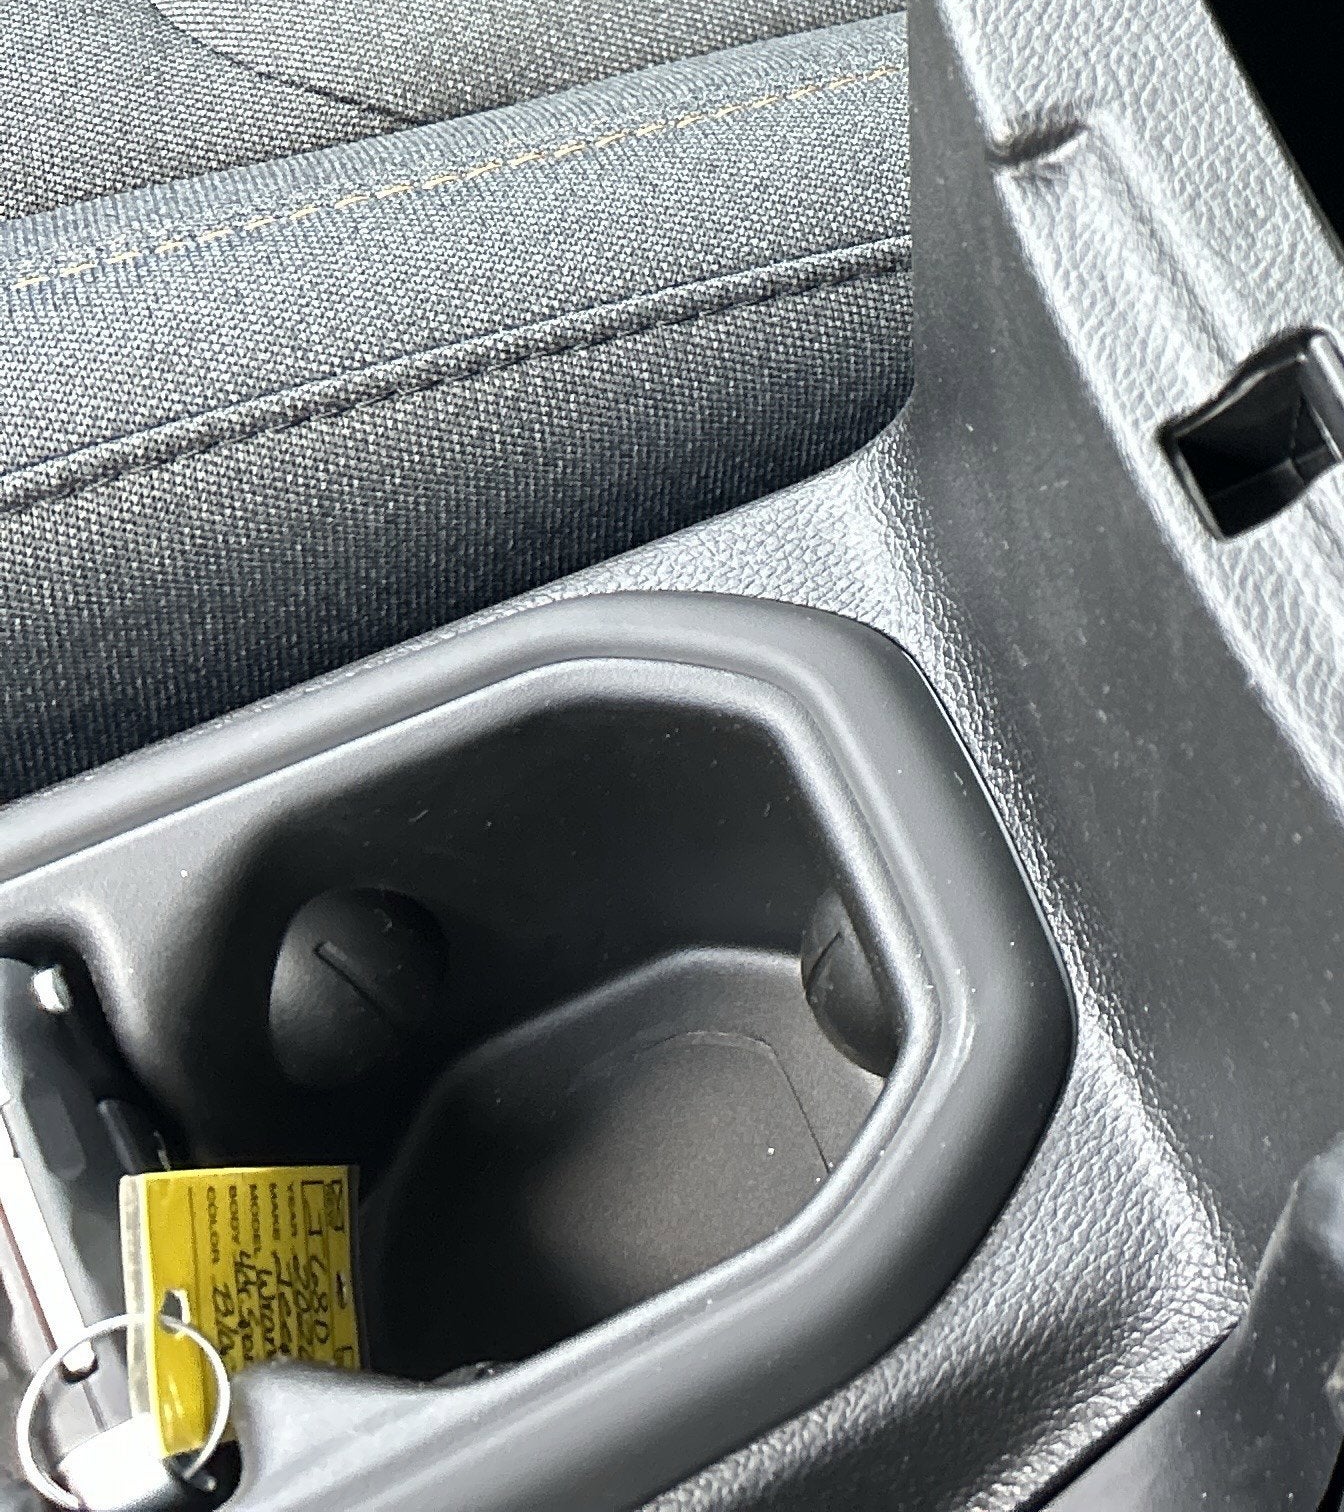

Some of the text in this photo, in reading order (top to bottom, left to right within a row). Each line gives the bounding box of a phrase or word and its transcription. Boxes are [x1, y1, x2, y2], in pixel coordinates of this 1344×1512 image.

[207, 1186, 220, 1264] COLOR
[229, 1185, 241, 1244] BODY
[250, 1183, 262, 1253] MODEL
[269, 1182, 280, 1240] MAKE
[287, 1182, 298, 1237] YEAR
